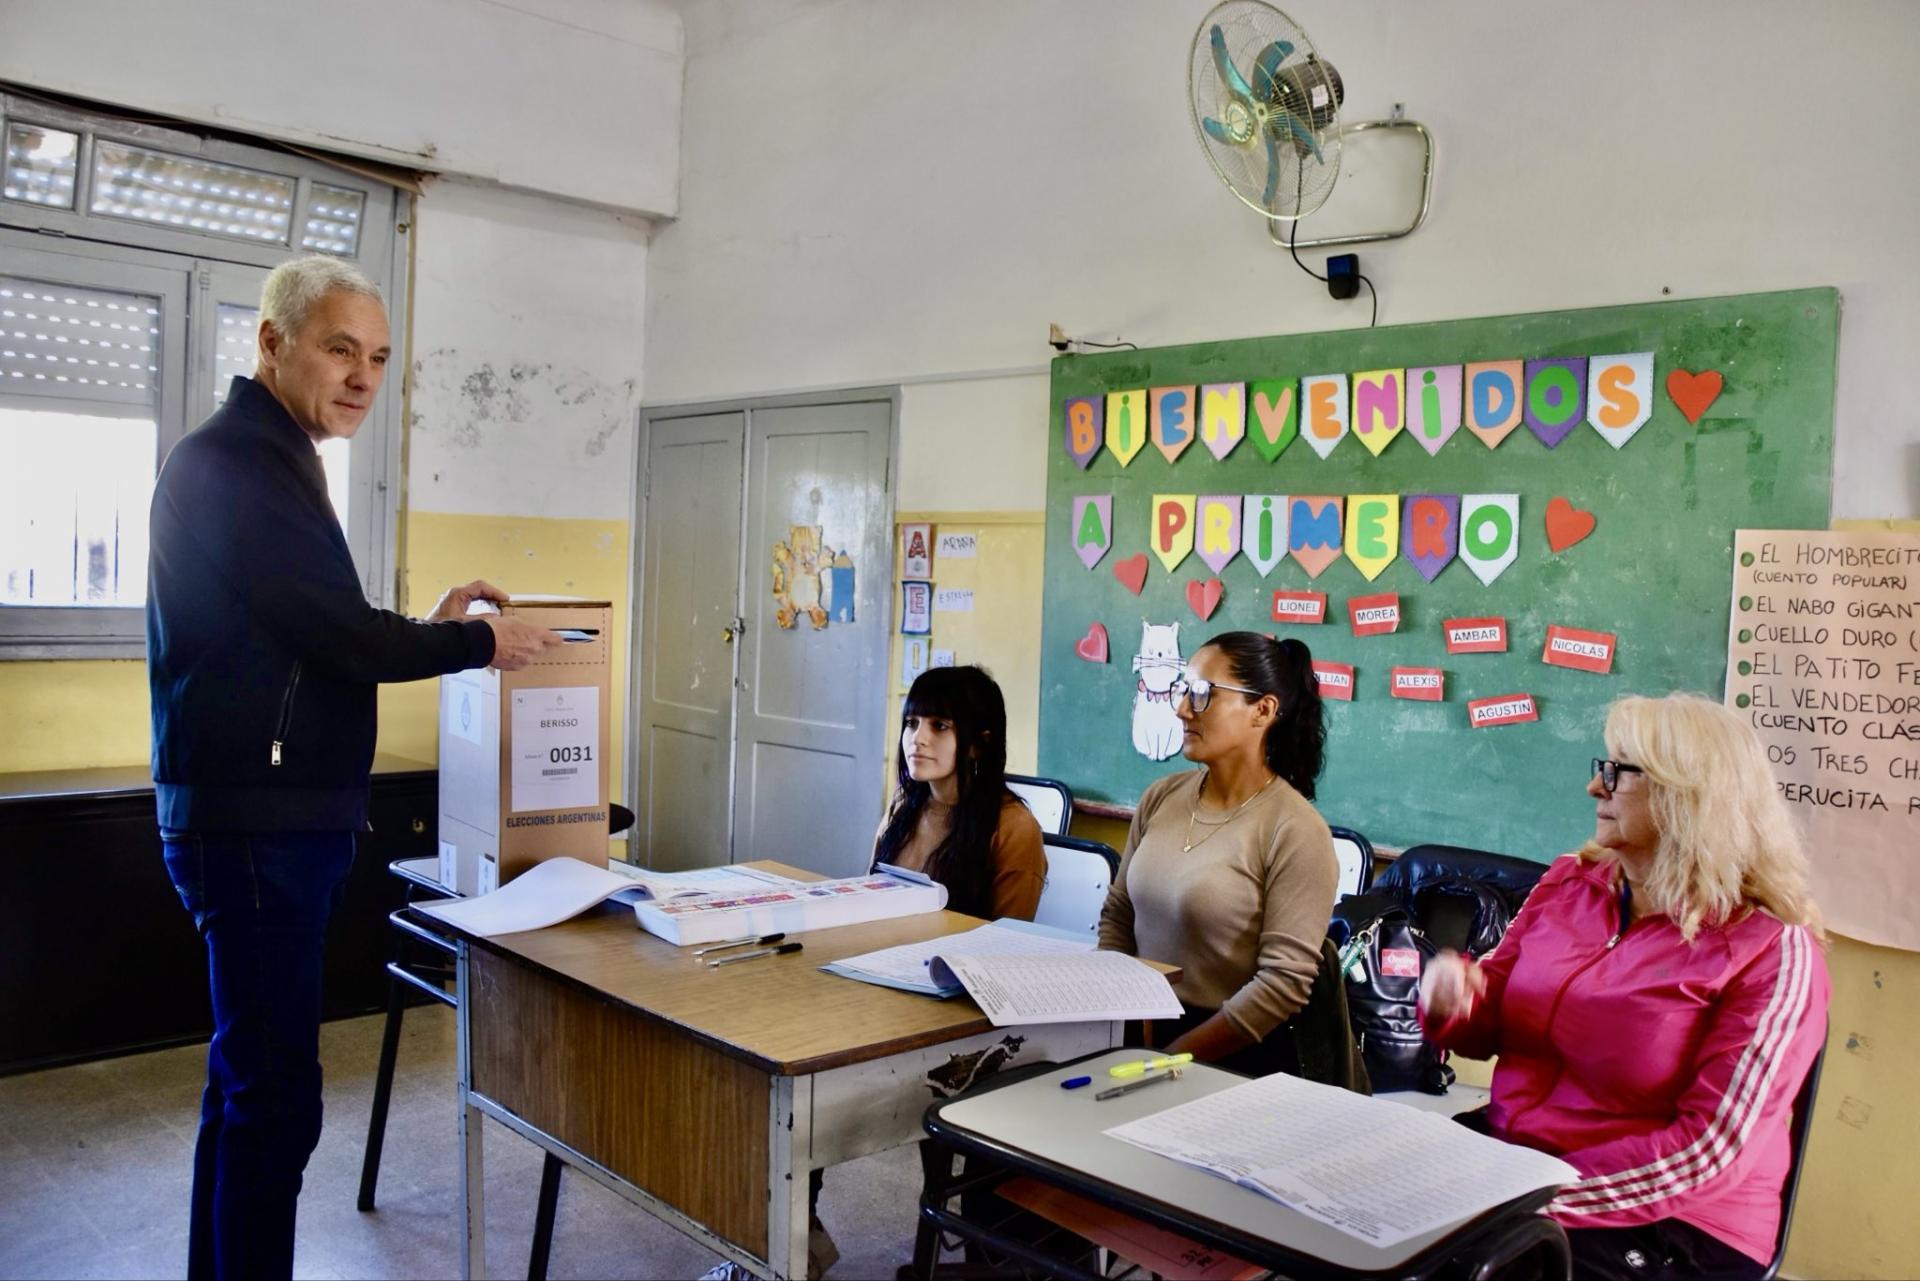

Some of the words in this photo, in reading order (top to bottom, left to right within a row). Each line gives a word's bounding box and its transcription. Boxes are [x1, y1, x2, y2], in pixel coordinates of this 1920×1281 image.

[1077, 501, 1107, 549] A
[908, 531, 926, 558] A
[1760, 543, 1781, 564] EL
[1753, 569, 1818, 585] (CUENTO
[1832, 573, 1907, 591] POPULAR)
[910, 587, 925, 614] E
[1279, 601, 1318, 612] LIONEL
[1757, 596, 1776, 613] EL
[1788, 598, 1835, 615] NABO
[1356, 609, 1396, 621] MOREA
[1454, 629, 1498, 642] AMBAR
[1754, 623, 1829, 645] CUELLO
[1842, 628, 1897, 648] DURO
[1554, 640, 1605, 657] NICOLAS
[1752, 652, 1782, 676] EL
[1398, 676, 1438, 687] ALEXIS
[1752, 684, 1780, 708] EL
[1792, 688, 1920, 714] VENDEDOR
[1478, 702, 1531, 719] AGUSTIN
[540, 718, 578, 728] BERISSO
[1752, 711, 1847, 735] (CUENTO
[550, 745, 592, 763] 0031
[1768, 745, 1796, 765] OS
[1810, 746, 1868, 775] TRES
[1889, 756, 1920, 780] CH
[506, 815, 556, 828] ELECCIONES
[557, 811, 606, 824] ARGENTINAS
